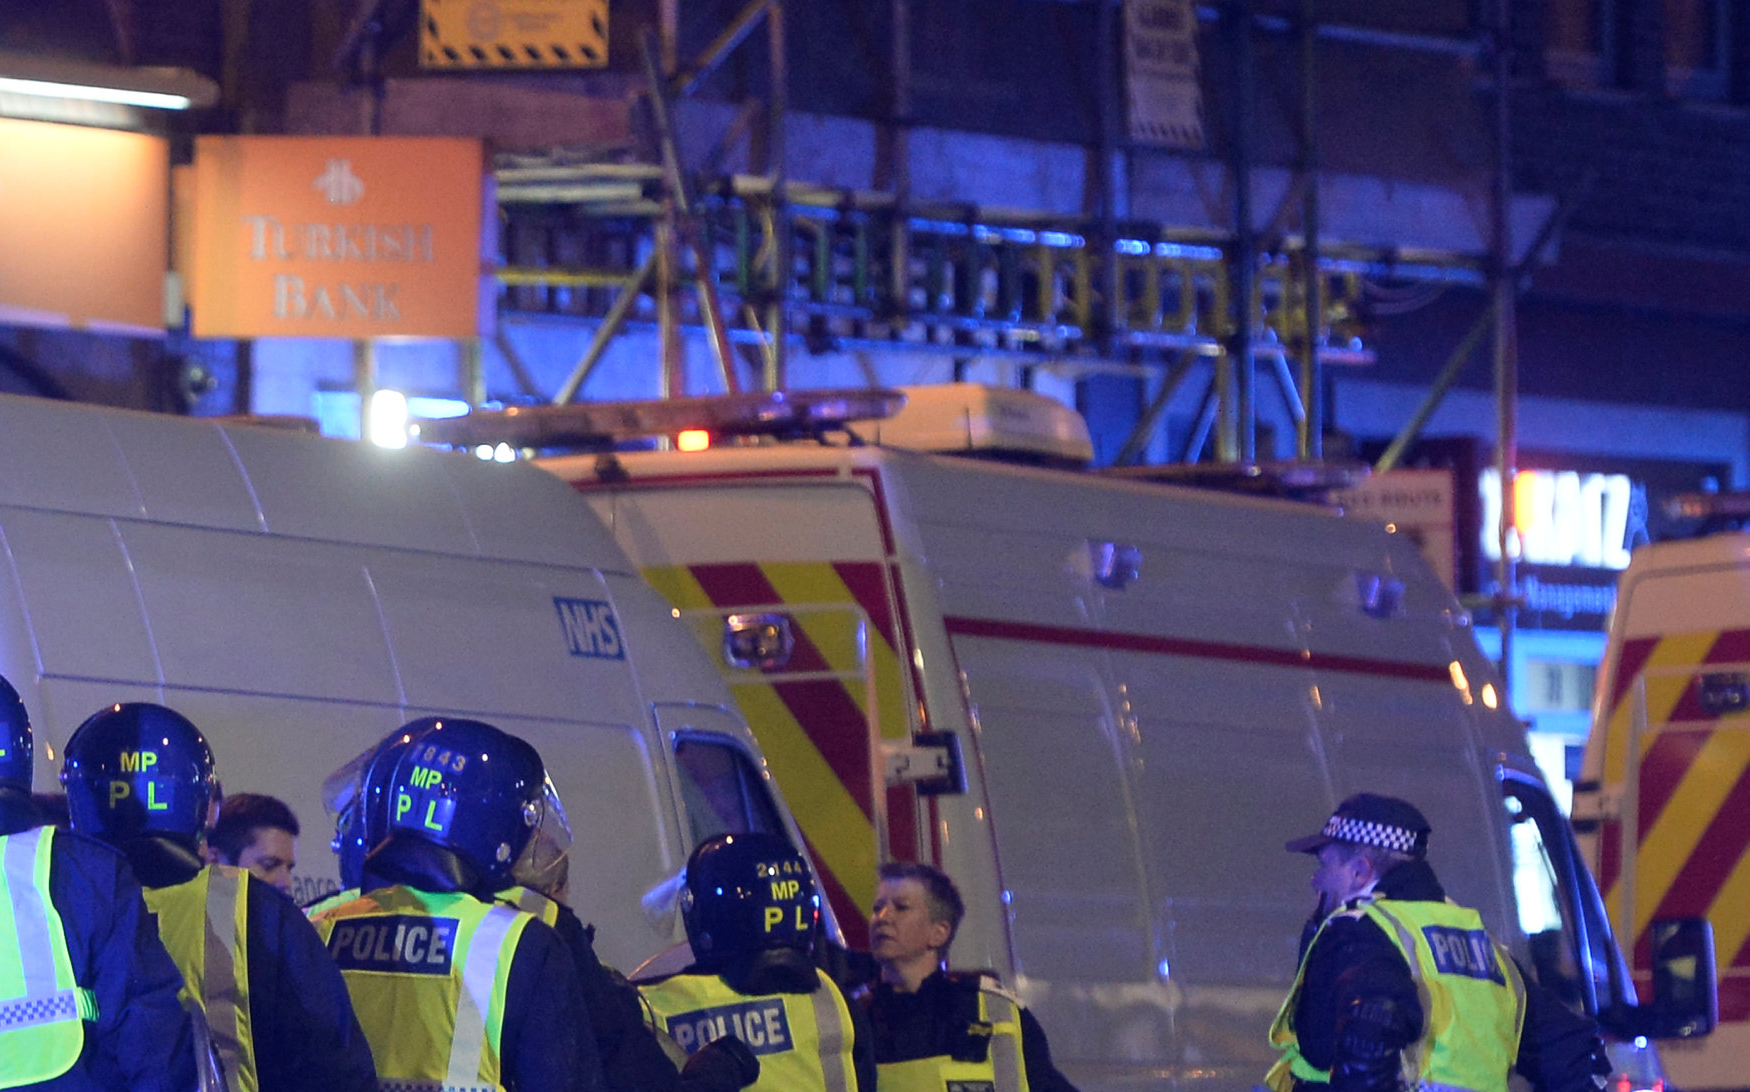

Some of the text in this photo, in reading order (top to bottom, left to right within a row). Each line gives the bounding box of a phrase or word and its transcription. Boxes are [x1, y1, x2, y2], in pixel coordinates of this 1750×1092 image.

[242, 214, 434, 262] TURKISH
[274, 275, 400, 321] BANK
[559, 603, 620, 656] NHS
[120, 751, 158, 772] MP
[410, 765, 443, 790] MP
[109, 781, 168, 811] P L
[396, 794, 443, 832] P L
[771, 880, 800, 901] MP
[764, 905, 809, 933] P L
[333, 924, 451, 964] POLICE
